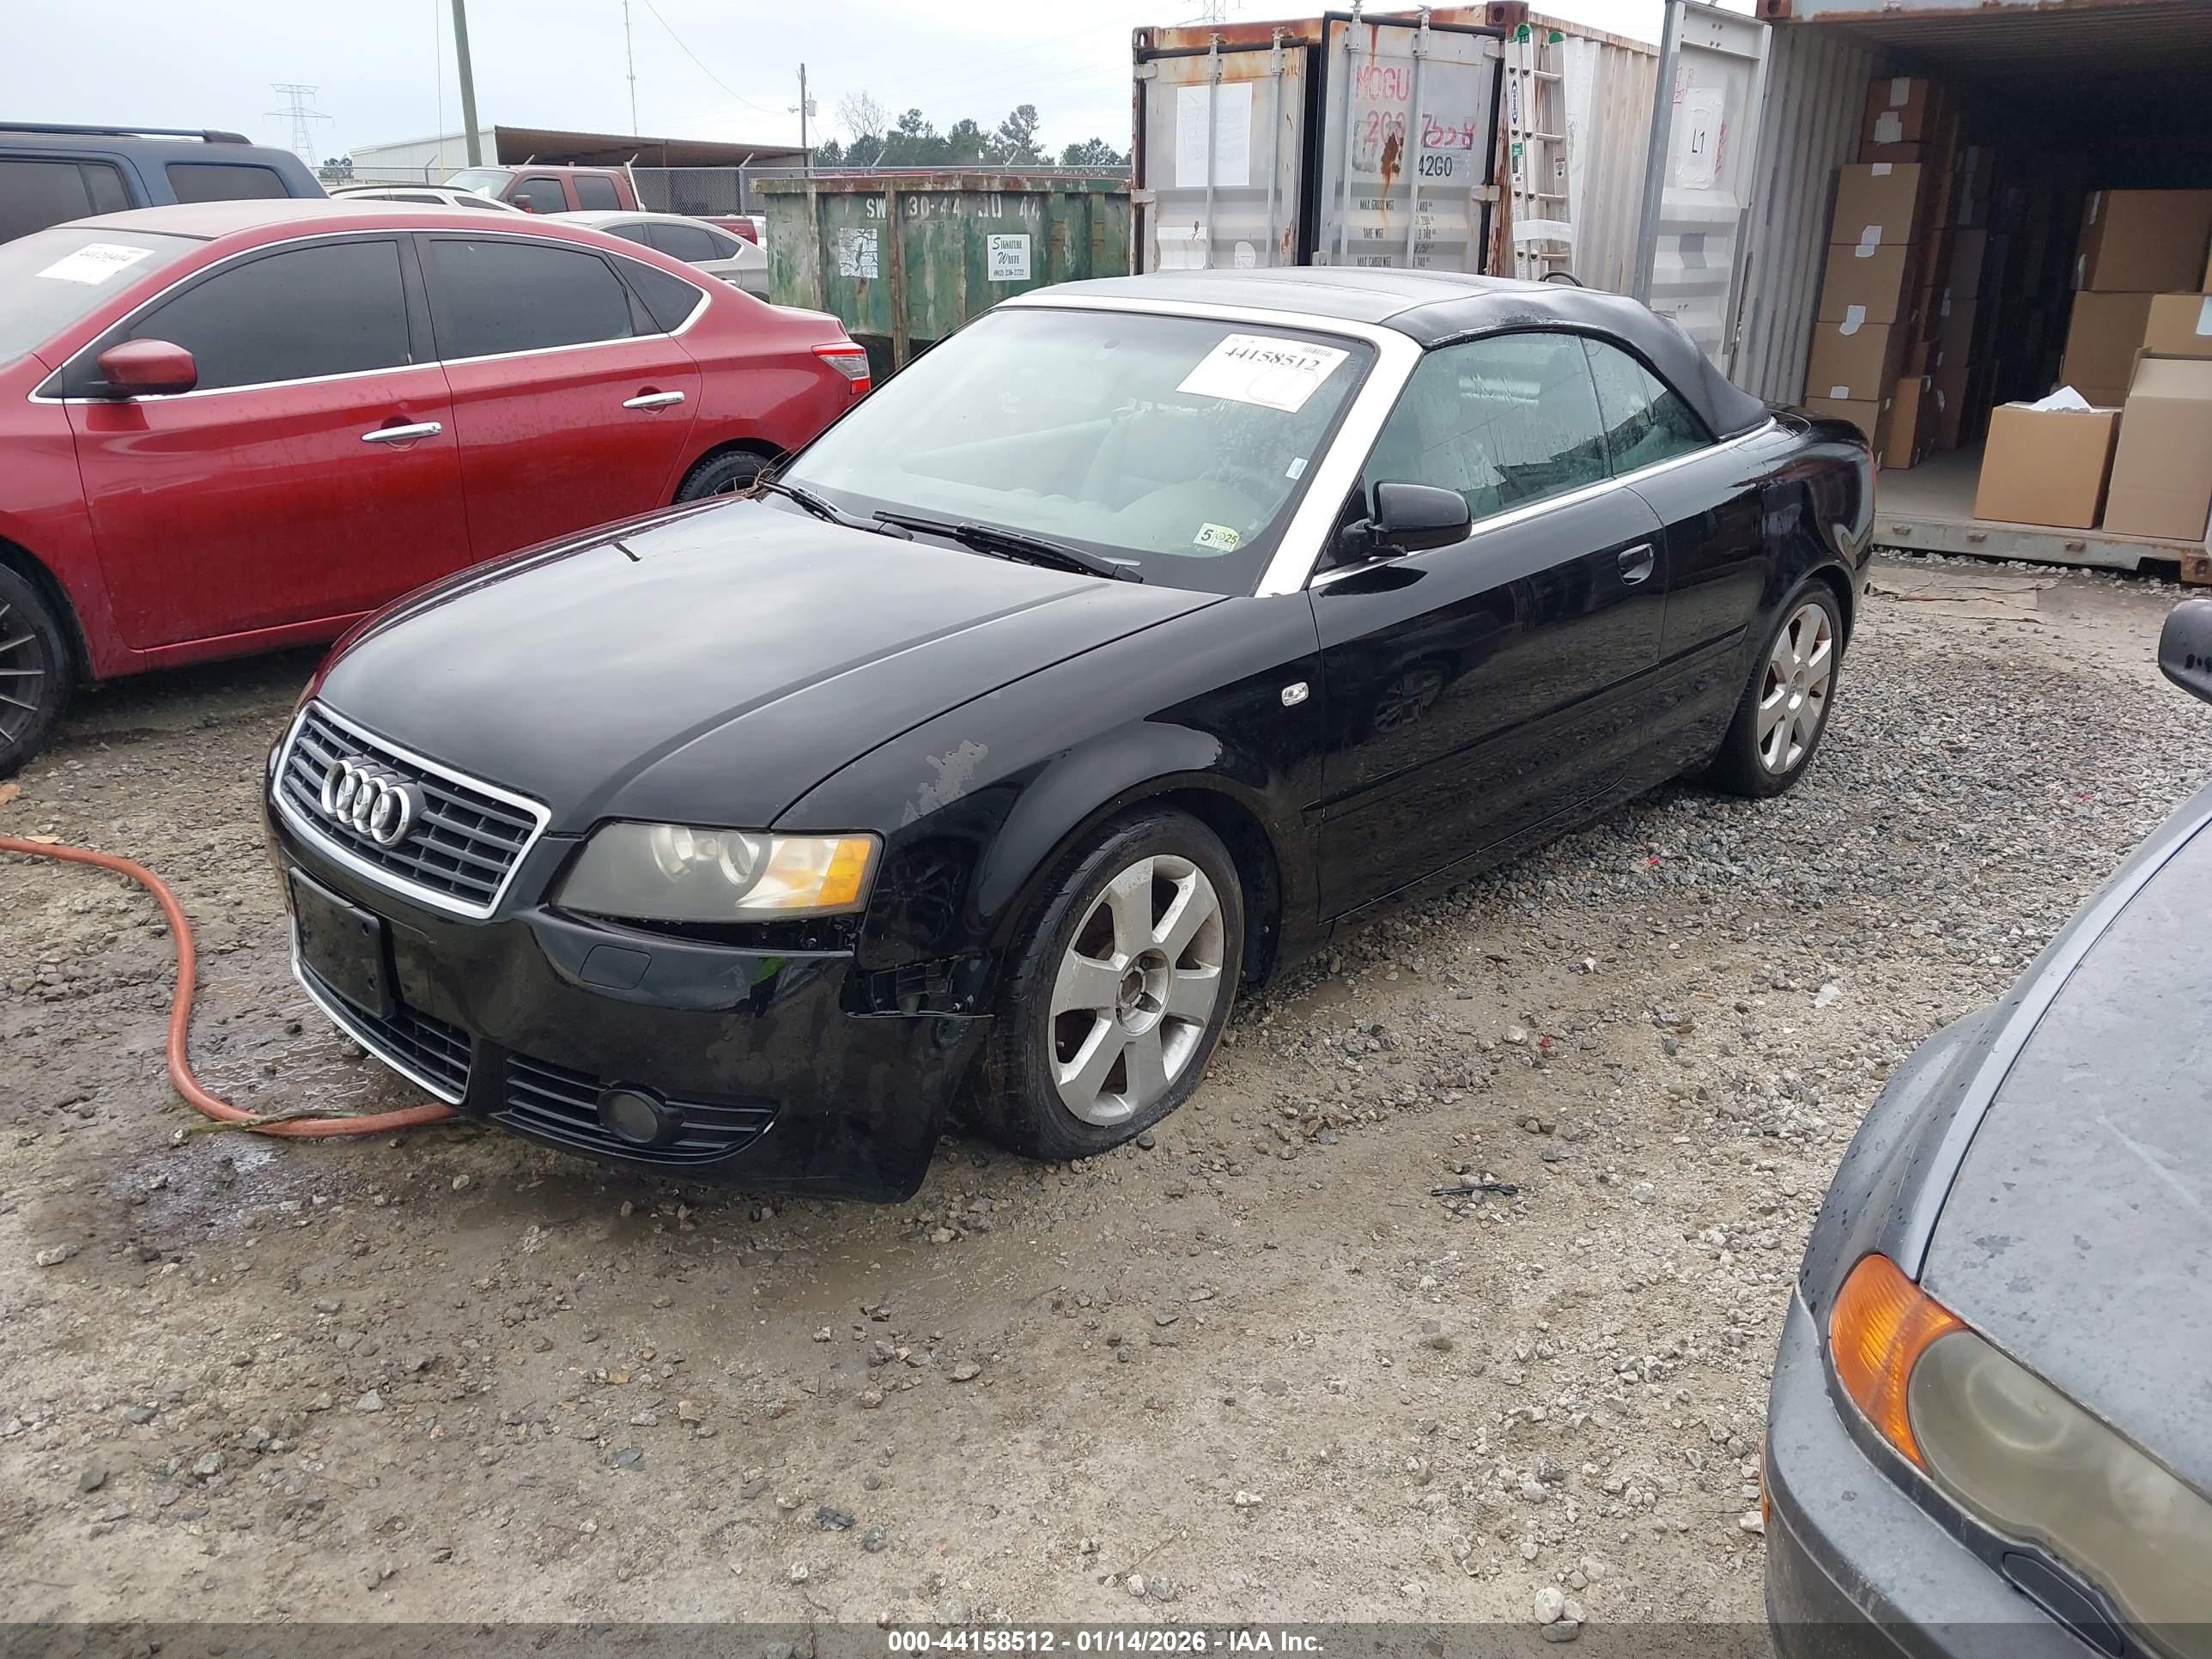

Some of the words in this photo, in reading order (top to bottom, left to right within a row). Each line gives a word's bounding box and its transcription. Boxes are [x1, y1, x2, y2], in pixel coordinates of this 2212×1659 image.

[1692, 128, 1705, 155] L1
[866, 198, 886, 219] SW
[1224, 346, 1321, 371] 44158512
[1200, 529, 1213, 542] 5
